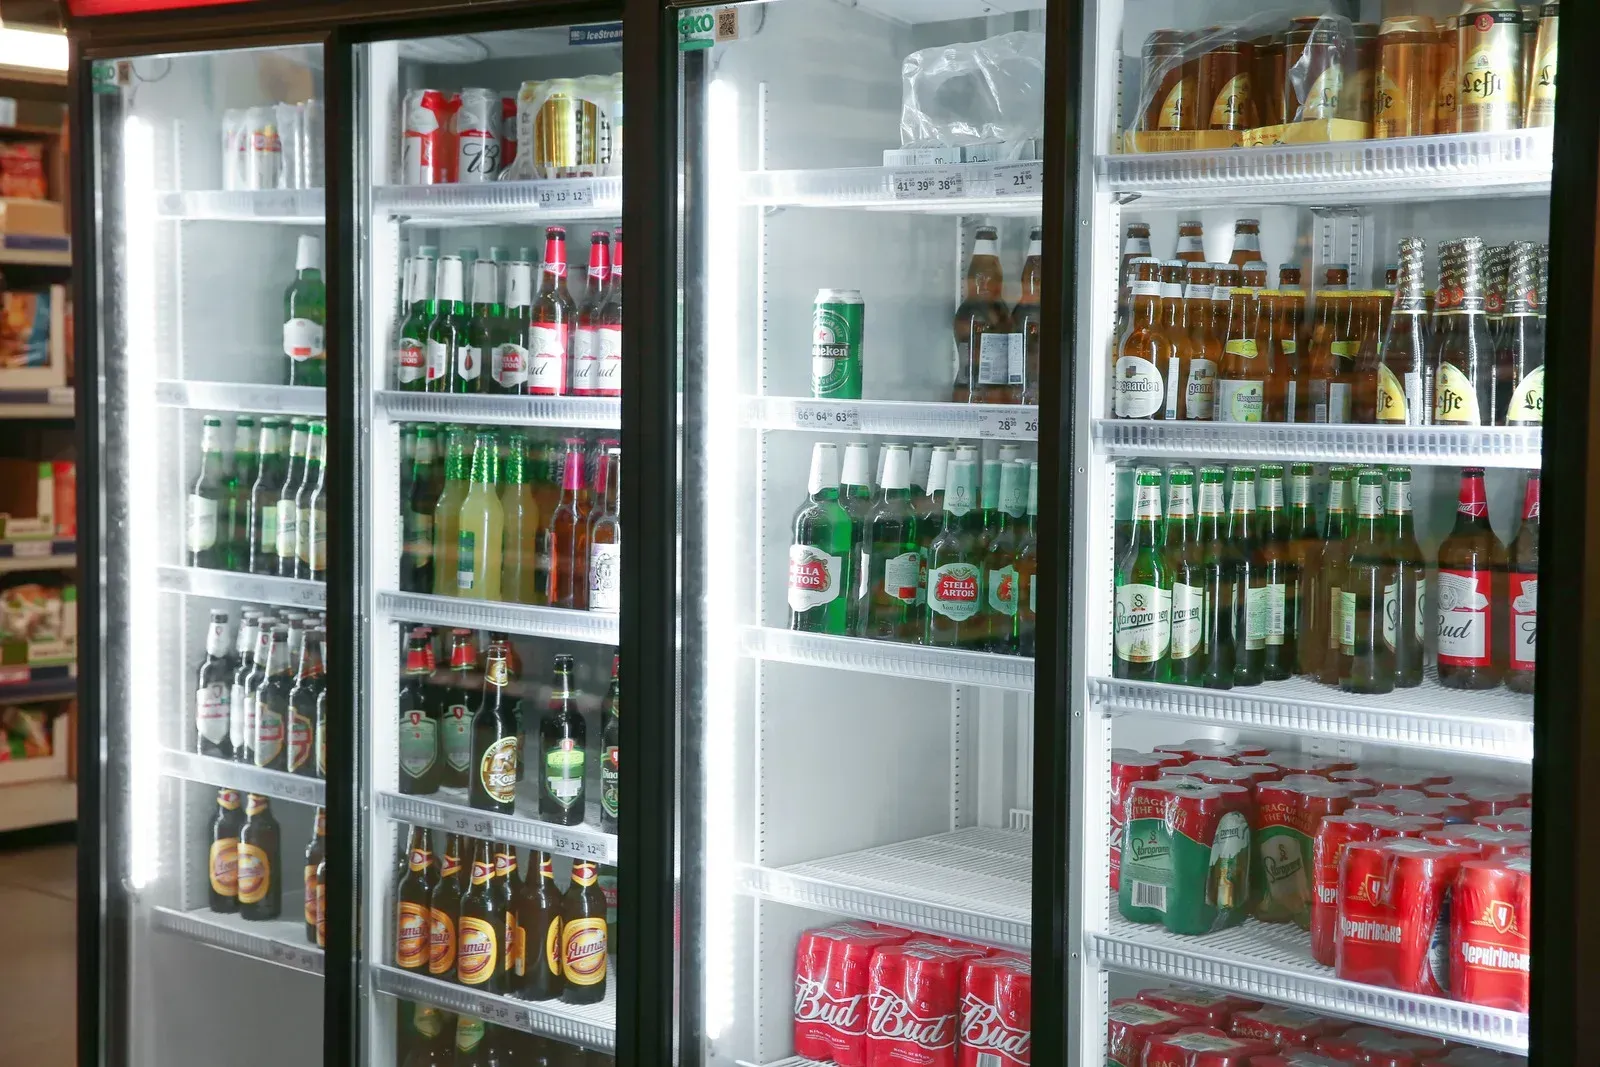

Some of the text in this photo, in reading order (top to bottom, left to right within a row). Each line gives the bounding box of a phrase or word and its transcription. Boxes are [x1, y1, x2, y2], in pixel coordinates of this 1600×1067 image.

[943, 581, 974, 589] STELLA
[794, 981, 862, 1027] Bud
[869, 994, 948, 1043] Bud
[960, 998, 1031, 1054] Bud
